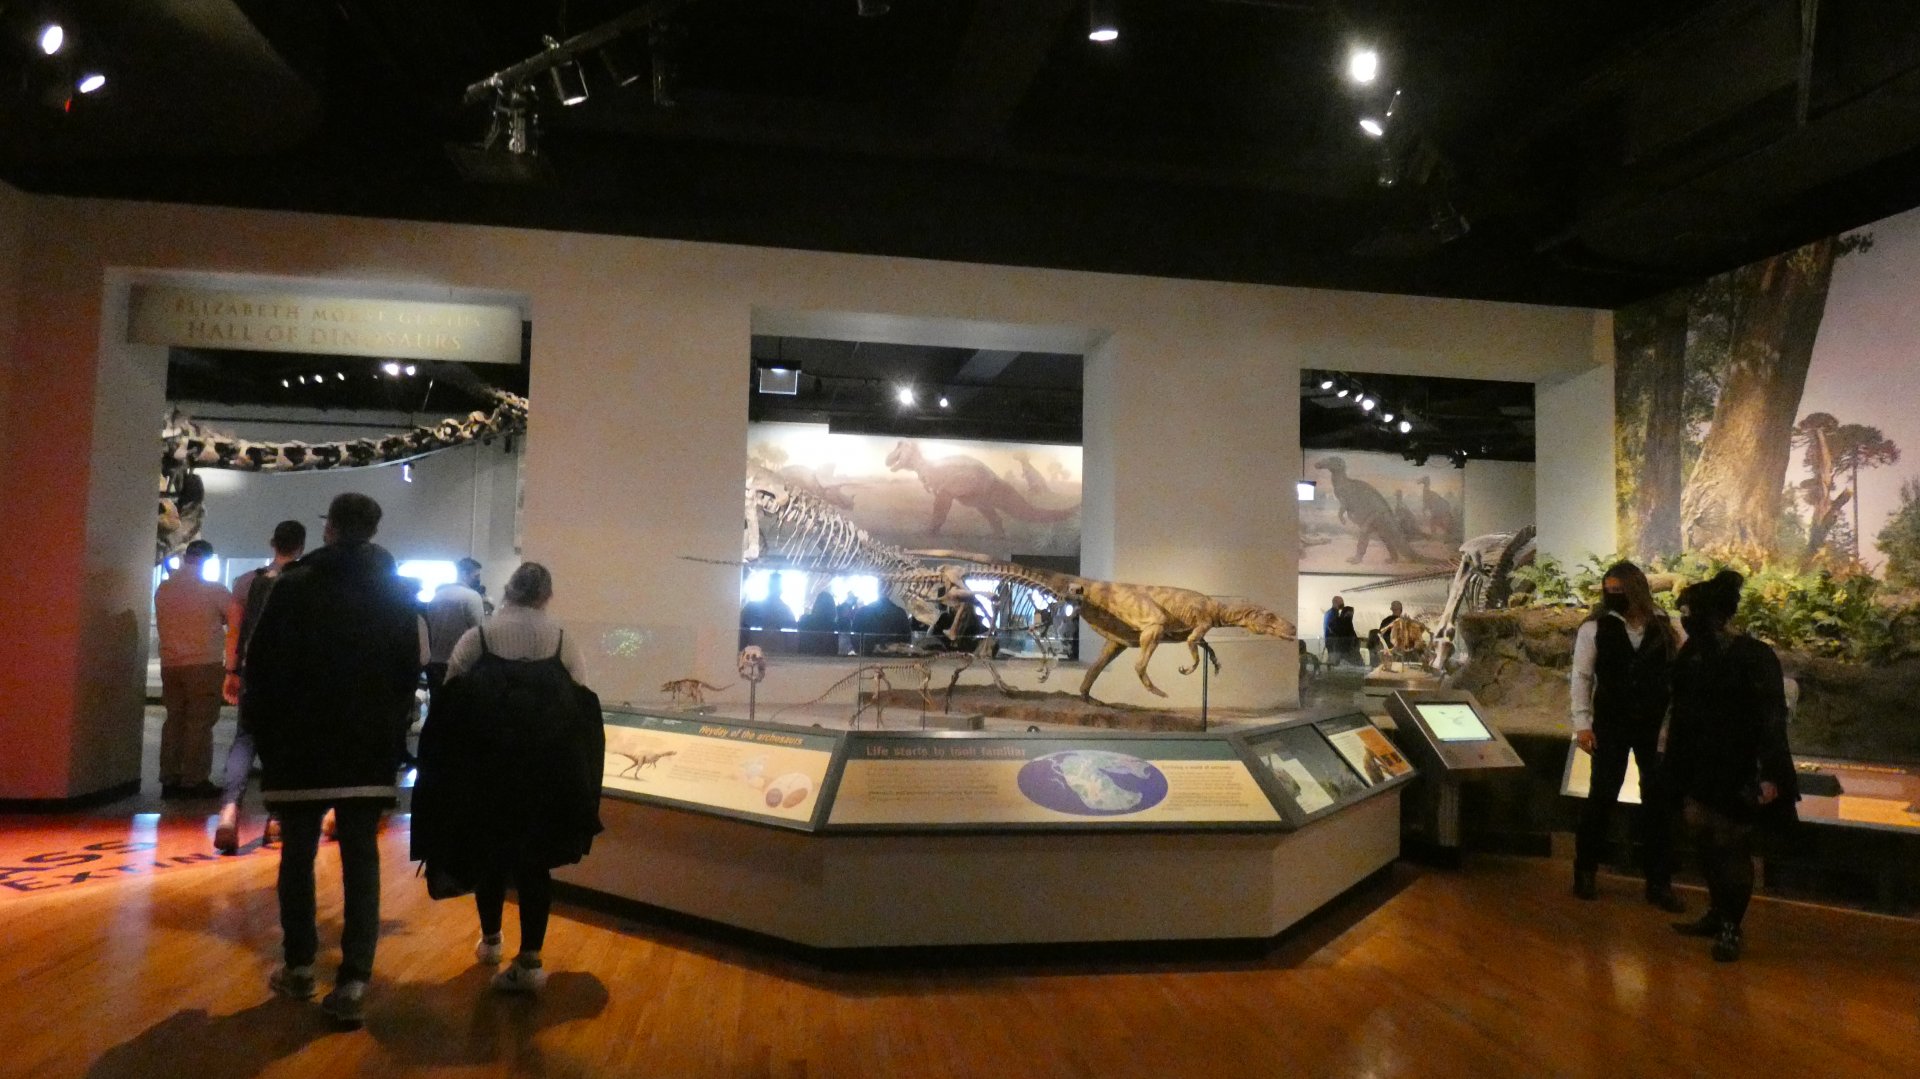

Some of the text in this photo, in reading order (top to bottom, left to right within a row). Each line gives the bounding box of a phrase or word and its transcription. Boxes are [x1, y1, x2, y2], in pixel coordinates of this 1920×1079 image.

[188, 321, 251, 341] HALL
[264, 325, 298, 344] OF
[867, 746, 889, 756] Life
